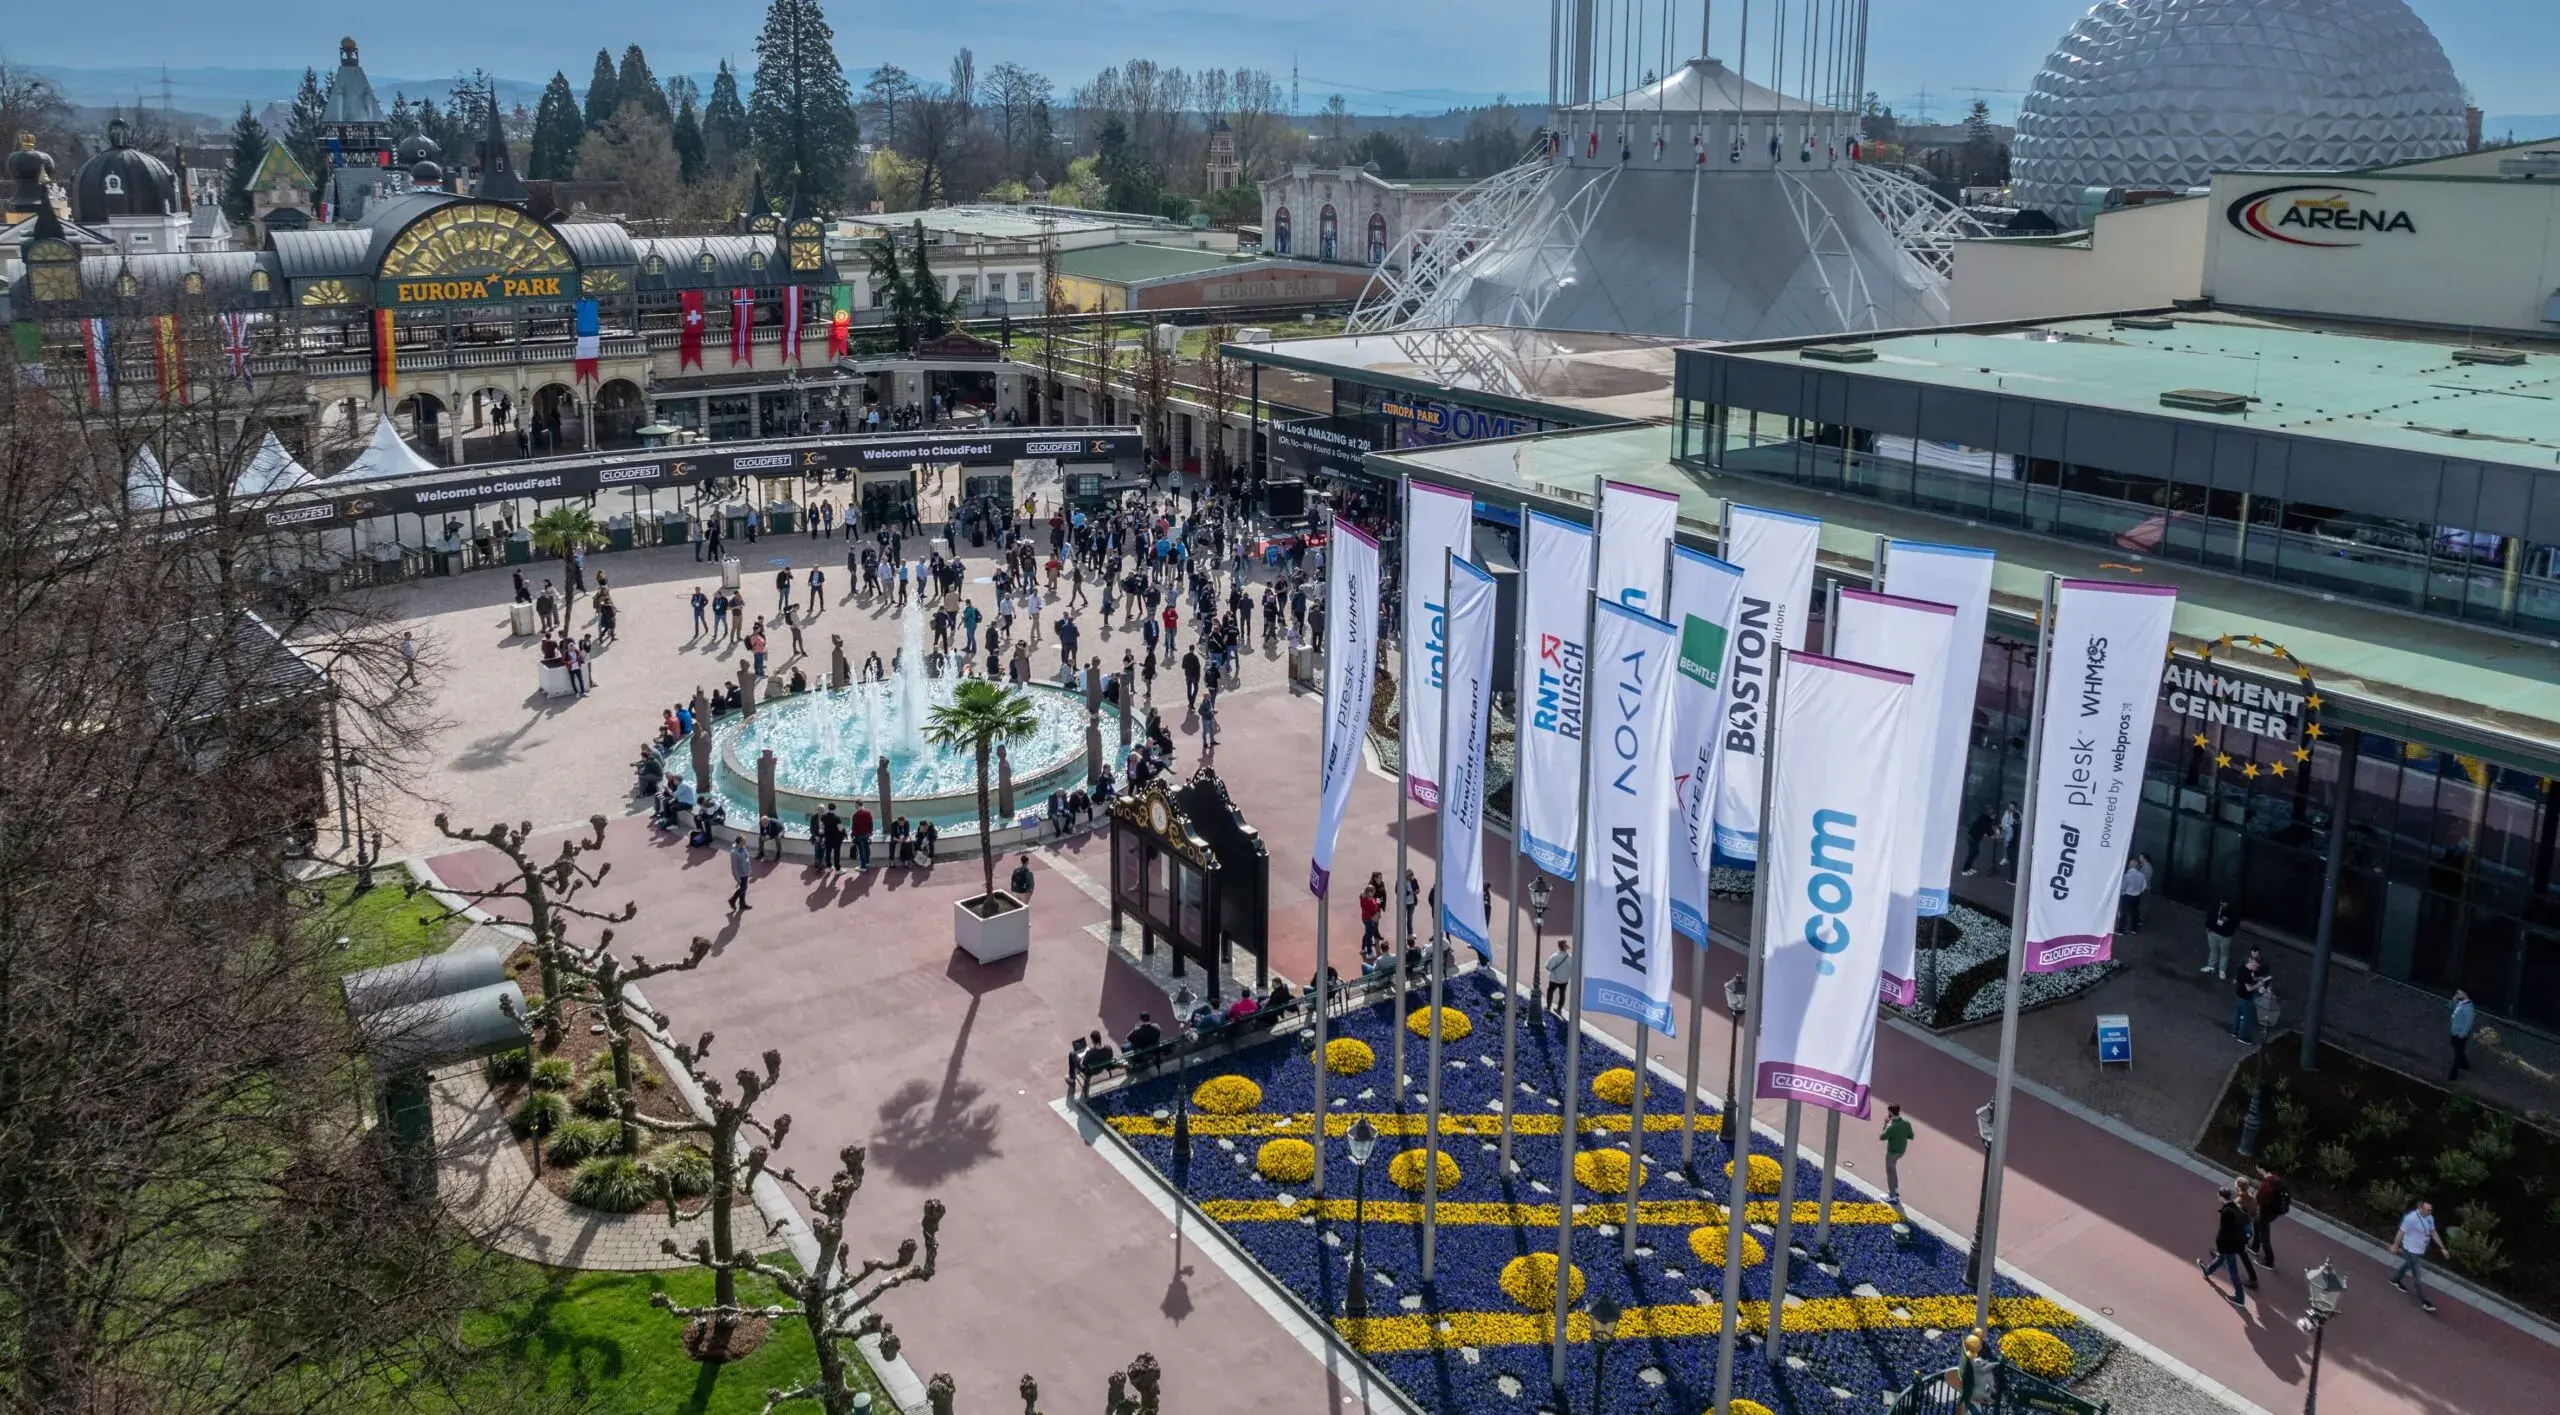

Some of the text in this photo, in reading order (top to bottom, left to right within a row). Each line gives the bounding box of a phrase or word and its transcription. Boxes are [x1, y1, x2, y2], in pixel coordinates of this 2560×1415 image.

[2278, 206, 2416, 234] ARENA
[397, 277, 561, 302] EUROPA PARK
[1220, 280, 1320, 298] EUROPA PARK
[1273, 419, 1371, 452] We Look AMAZING at 20!
[1382, 401, 1440, 424] EUROPA PARK
[735, 456, 790, 468] CLOUDFEST
[863, 444, 992, 460] Welcome to CloudFest!
[1028, 442, 1080, 452] CLOUDFEST
[1313, 445, 1332, 456] Found
[1336, 451, 1350, 461] Grey
[416, 476, 561, 503] Welcome to CloudFest!
[602, 467, 658, 481] CLOUDFEST
[268, 507, 331, 525] CLOUDFEST
[1347, 573, 1357, 643] WHMCS
[1424, 601, 1446, 689] intel
[1680, 656, 1717, 683] BECHTLE
[1337, 661, 1355, 729] plesk
[1533, 667, 1560, 732] RNT
[1559, 640, 1584, 741] RAUSCH
[1726, 596, 1771, 755] BOSTON
[2081, 637, 2108, 718] WHMCS
[2163, 665, 2305, 717] AINMENT
[1341, 649, 1369, 776] powered by webpros
[1612, 650, 1646, 796] NOKIA
[2169, 692, 2289, 741] CENTER
[1458, 678, 1479, 827] Hewlett Packard
[2064, 736, 2097, 807] plesk
[2101, 713, 2131, 848] powered by webpros
[1690, 746, 1709, 870] AMPERE
[2049, 823, 2081, 901] cPanel
[1612, 826, 1647, 975] KIOXIA
[1805, 808, 1857, 977] .com
[2043, 945, 2098, 962] CLOUDFEST
[1601, 991, 1666, 1021] CLOUDFEST
[1774, 1074, 1856, 1104] CLOUDFEST
